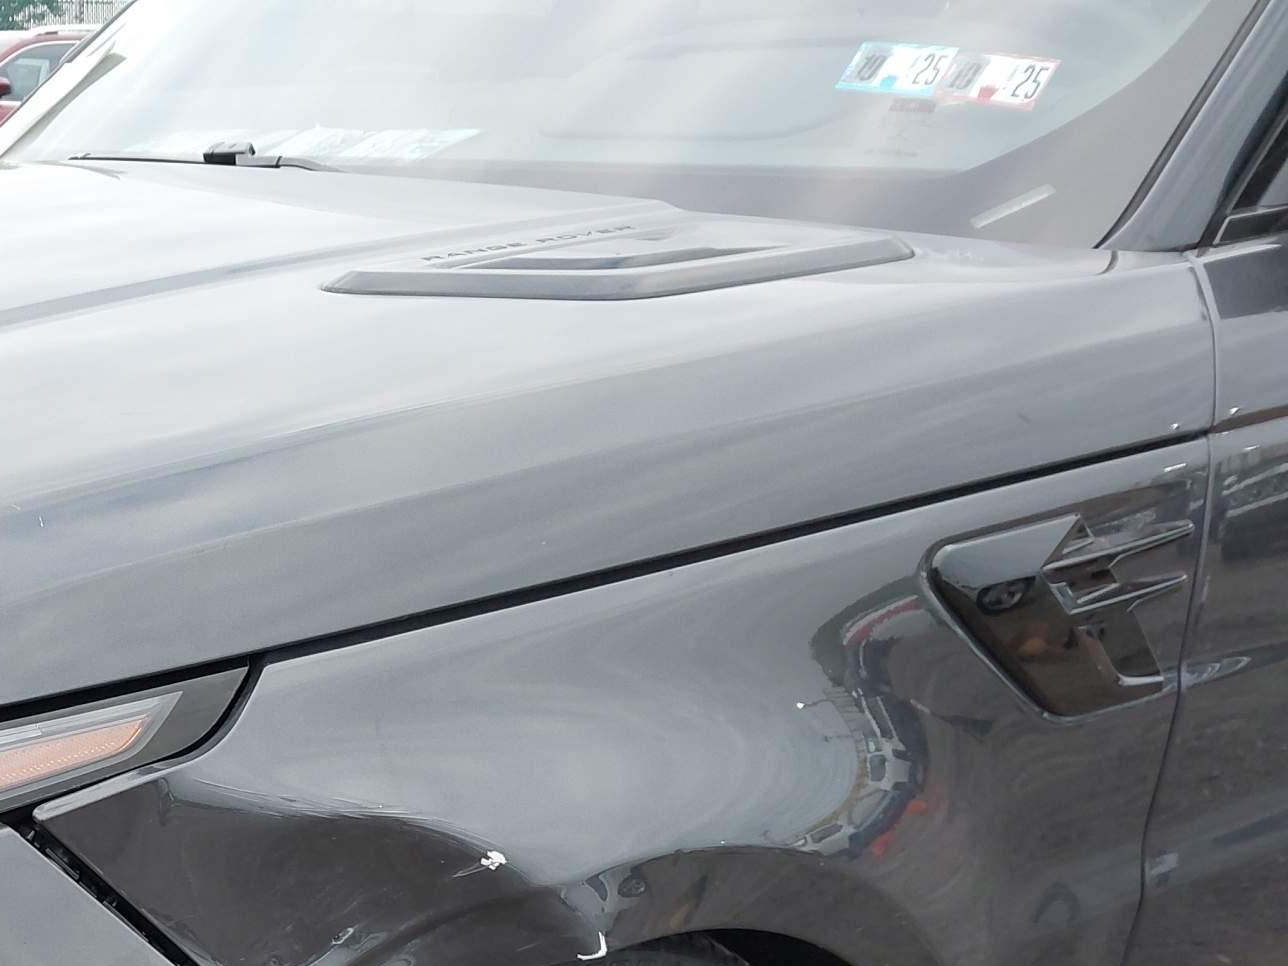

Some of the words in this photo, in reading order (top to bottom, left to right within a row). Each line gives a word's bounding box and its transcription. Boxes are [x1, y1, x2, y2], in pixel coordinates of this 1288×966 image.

[911, 53, 951, 86] 25
[1010, 63, 1050, 100] 25
[420, 241, 528, 261] RANGE
[535, 224, 636, 244] ROVER
